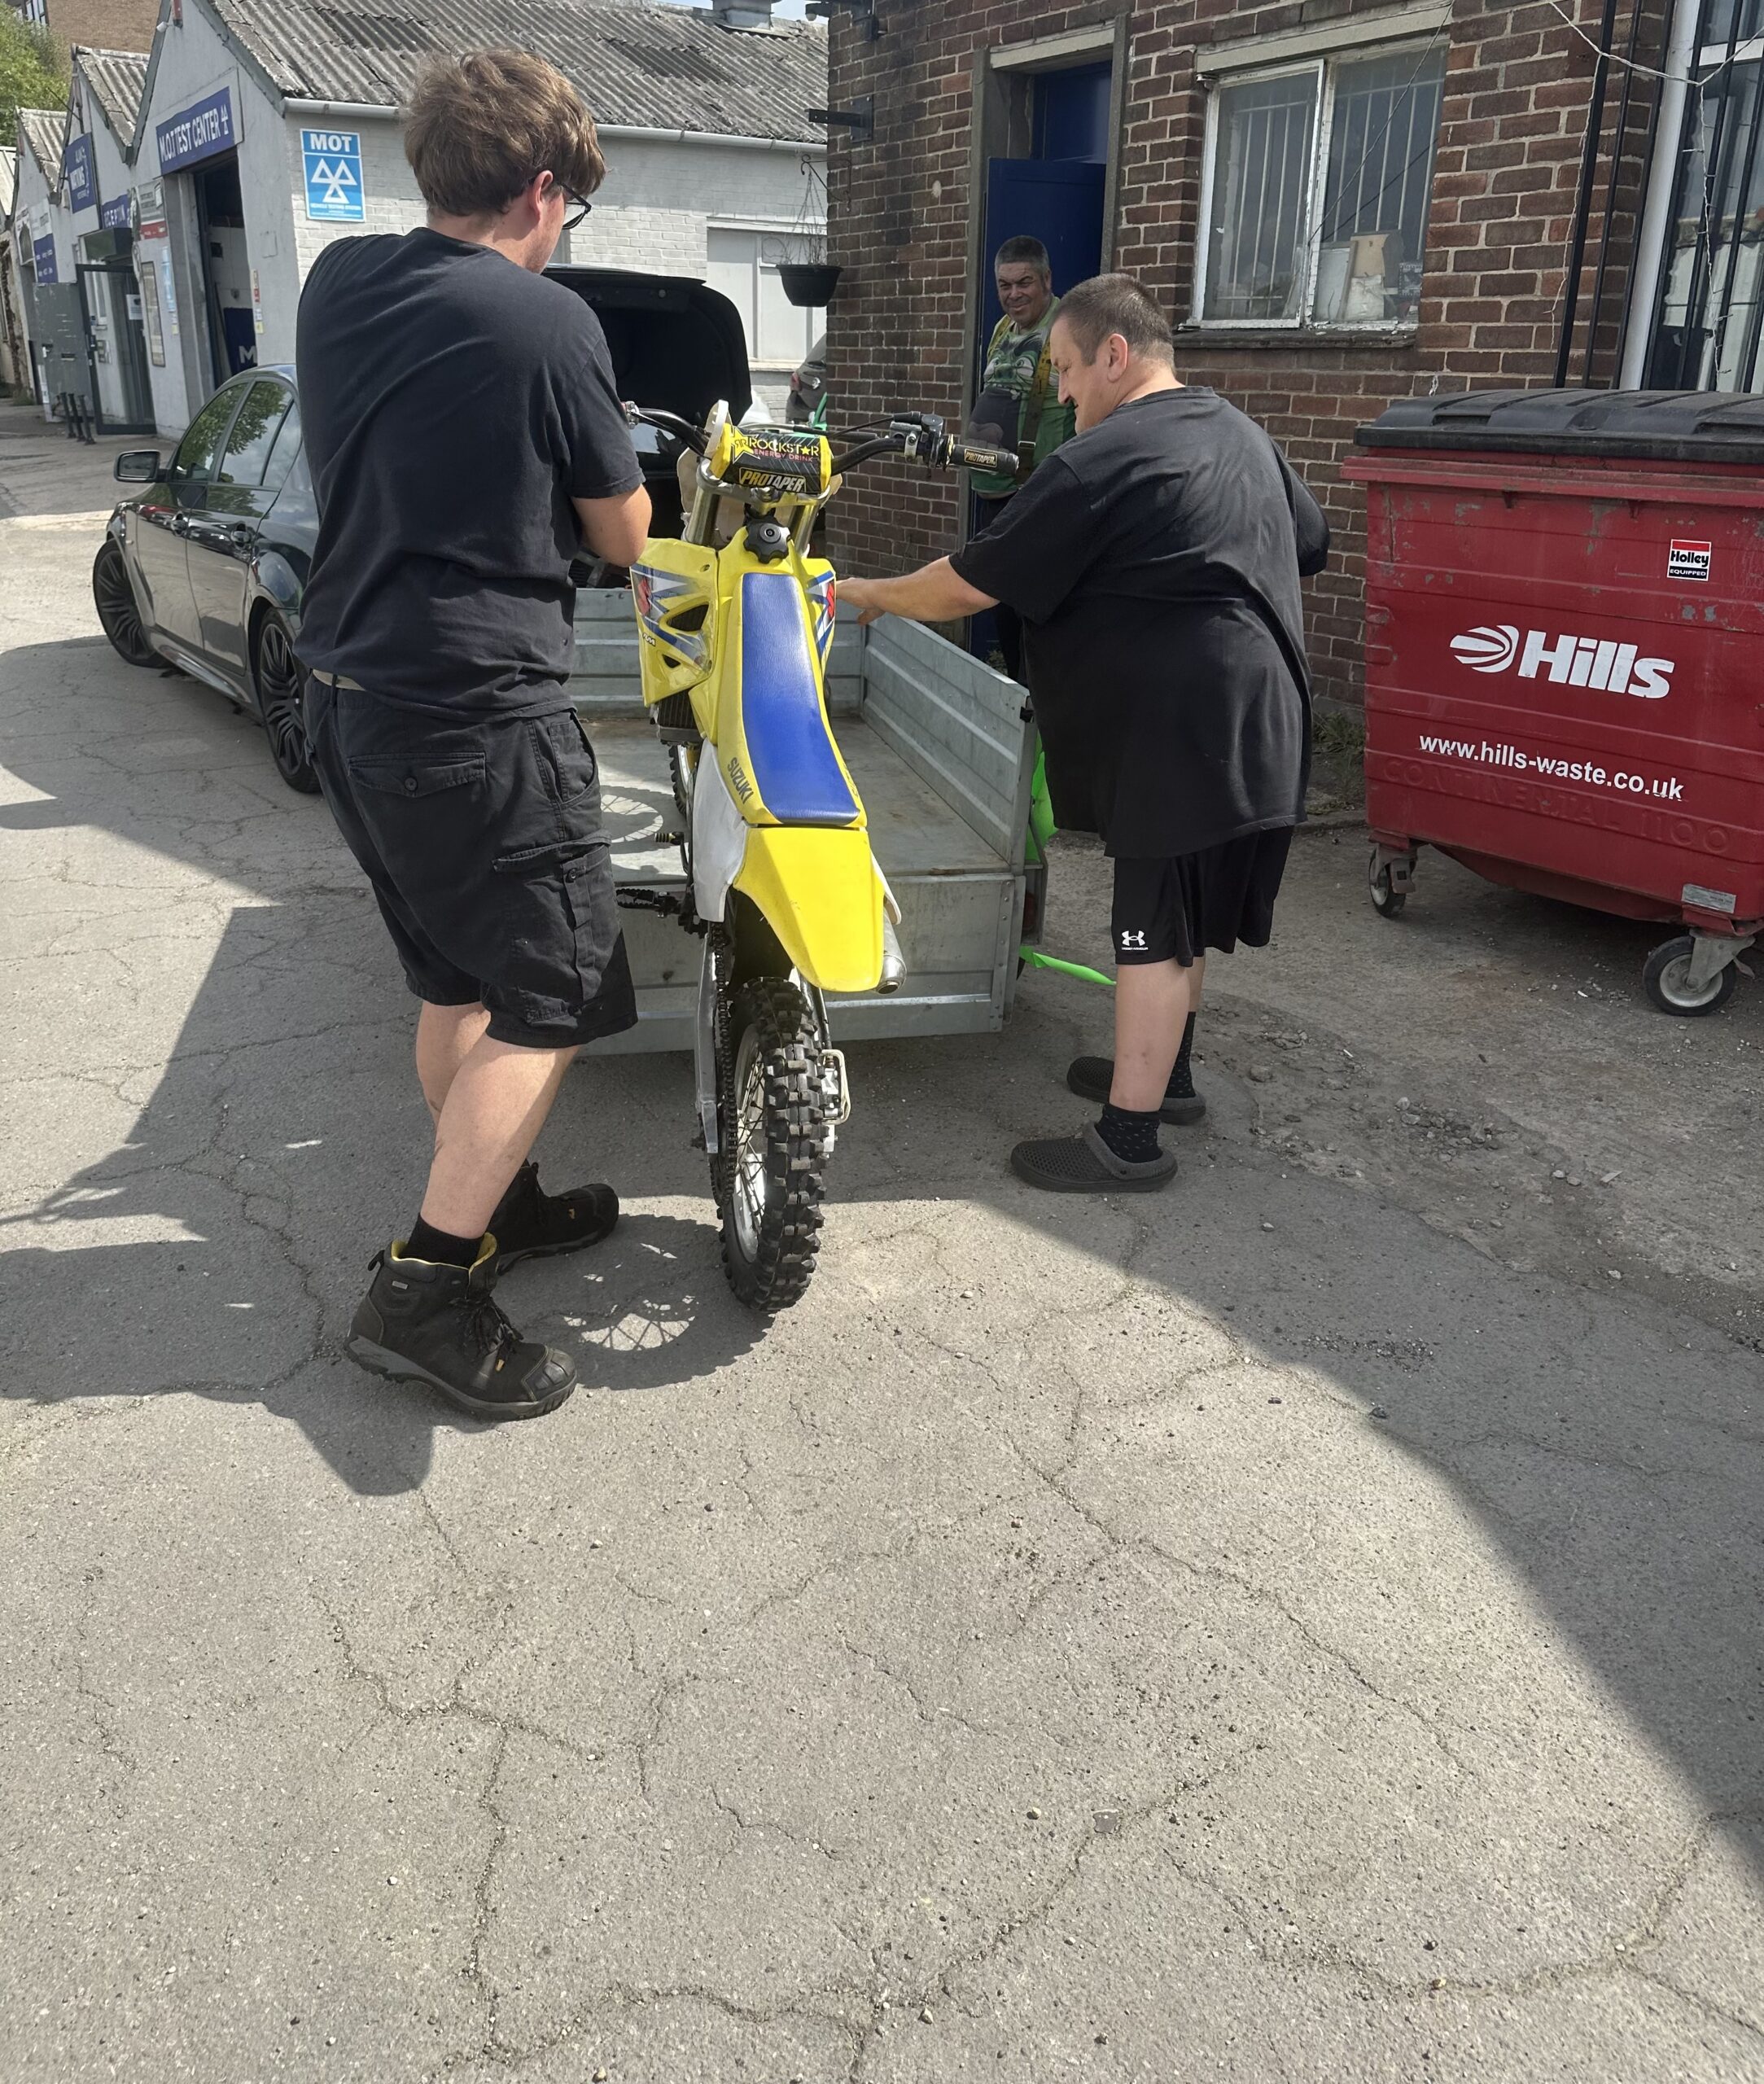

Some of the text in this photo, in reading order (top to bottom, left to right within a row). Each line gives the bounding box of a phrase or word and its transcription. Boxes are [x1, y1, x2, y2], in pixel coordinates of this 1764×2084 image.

[174, 122, 191, 155] TEST
[192, 108, 221, 147] CENTER
[310, 134, 352, 152] MOT
[754, 449, 813, 462] ENERGY DRINK
[741, 471, 806, 493] PROTAPER
[1670, 550, 1709, 567] Holley
[1517, 630, 1675, 698] Hills
[727, 757, 754, 804] SUZUKI
[1419, 735, 1684, 801] www.hills-waste.co.uk
